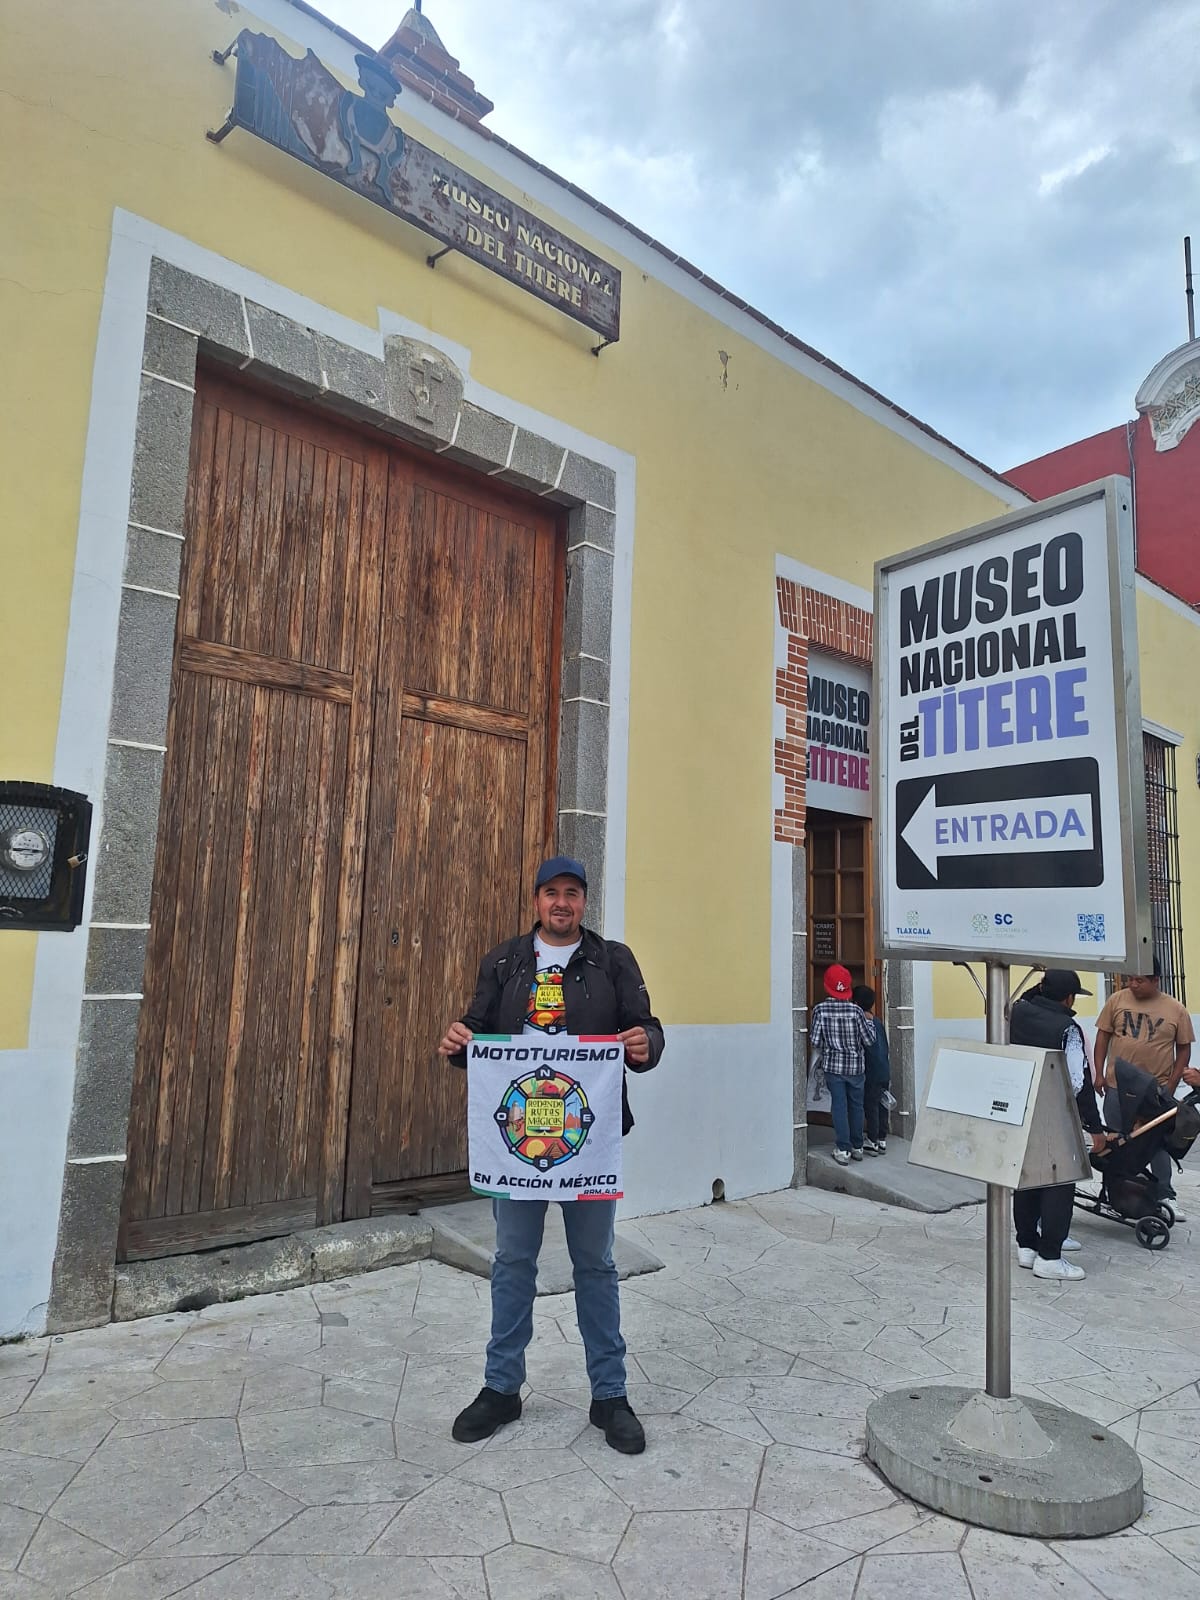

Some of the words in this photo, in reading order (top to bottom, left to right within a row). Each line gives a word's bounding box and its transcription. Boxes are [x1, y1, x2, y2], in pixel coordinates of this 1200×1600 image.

[467, 223, 507, 264] DEL
[514, 250, 582, 308] TITERE
[900, 532, 1084, 648] MUSEO
[900, 612, 1086, 697] NACIONAL
[806, 675, 870, 726] MUSEO
[918, 667, 1089, 758] TÍTERE
[900, 715, 919, 762] DEL
[810, 743, 870, 791] TÍTERE
[935, 808, 1086, 844] ENTRADA
[896, 927, 931, 935] TLAXCALA
[994, 913, 1013, 925] SC
[1122, 1011, 1164, 1042] NY
[540, 1069, 551, 1077] N
[583, 1114, 592, 1122] E
[474, 1172, 491, 1184] EN
[496, 1174, 553, 1188] ACCIÓN
[559, 1173, 617, 1188] MÉXICO
[540, 1159, 548, 1167] S
